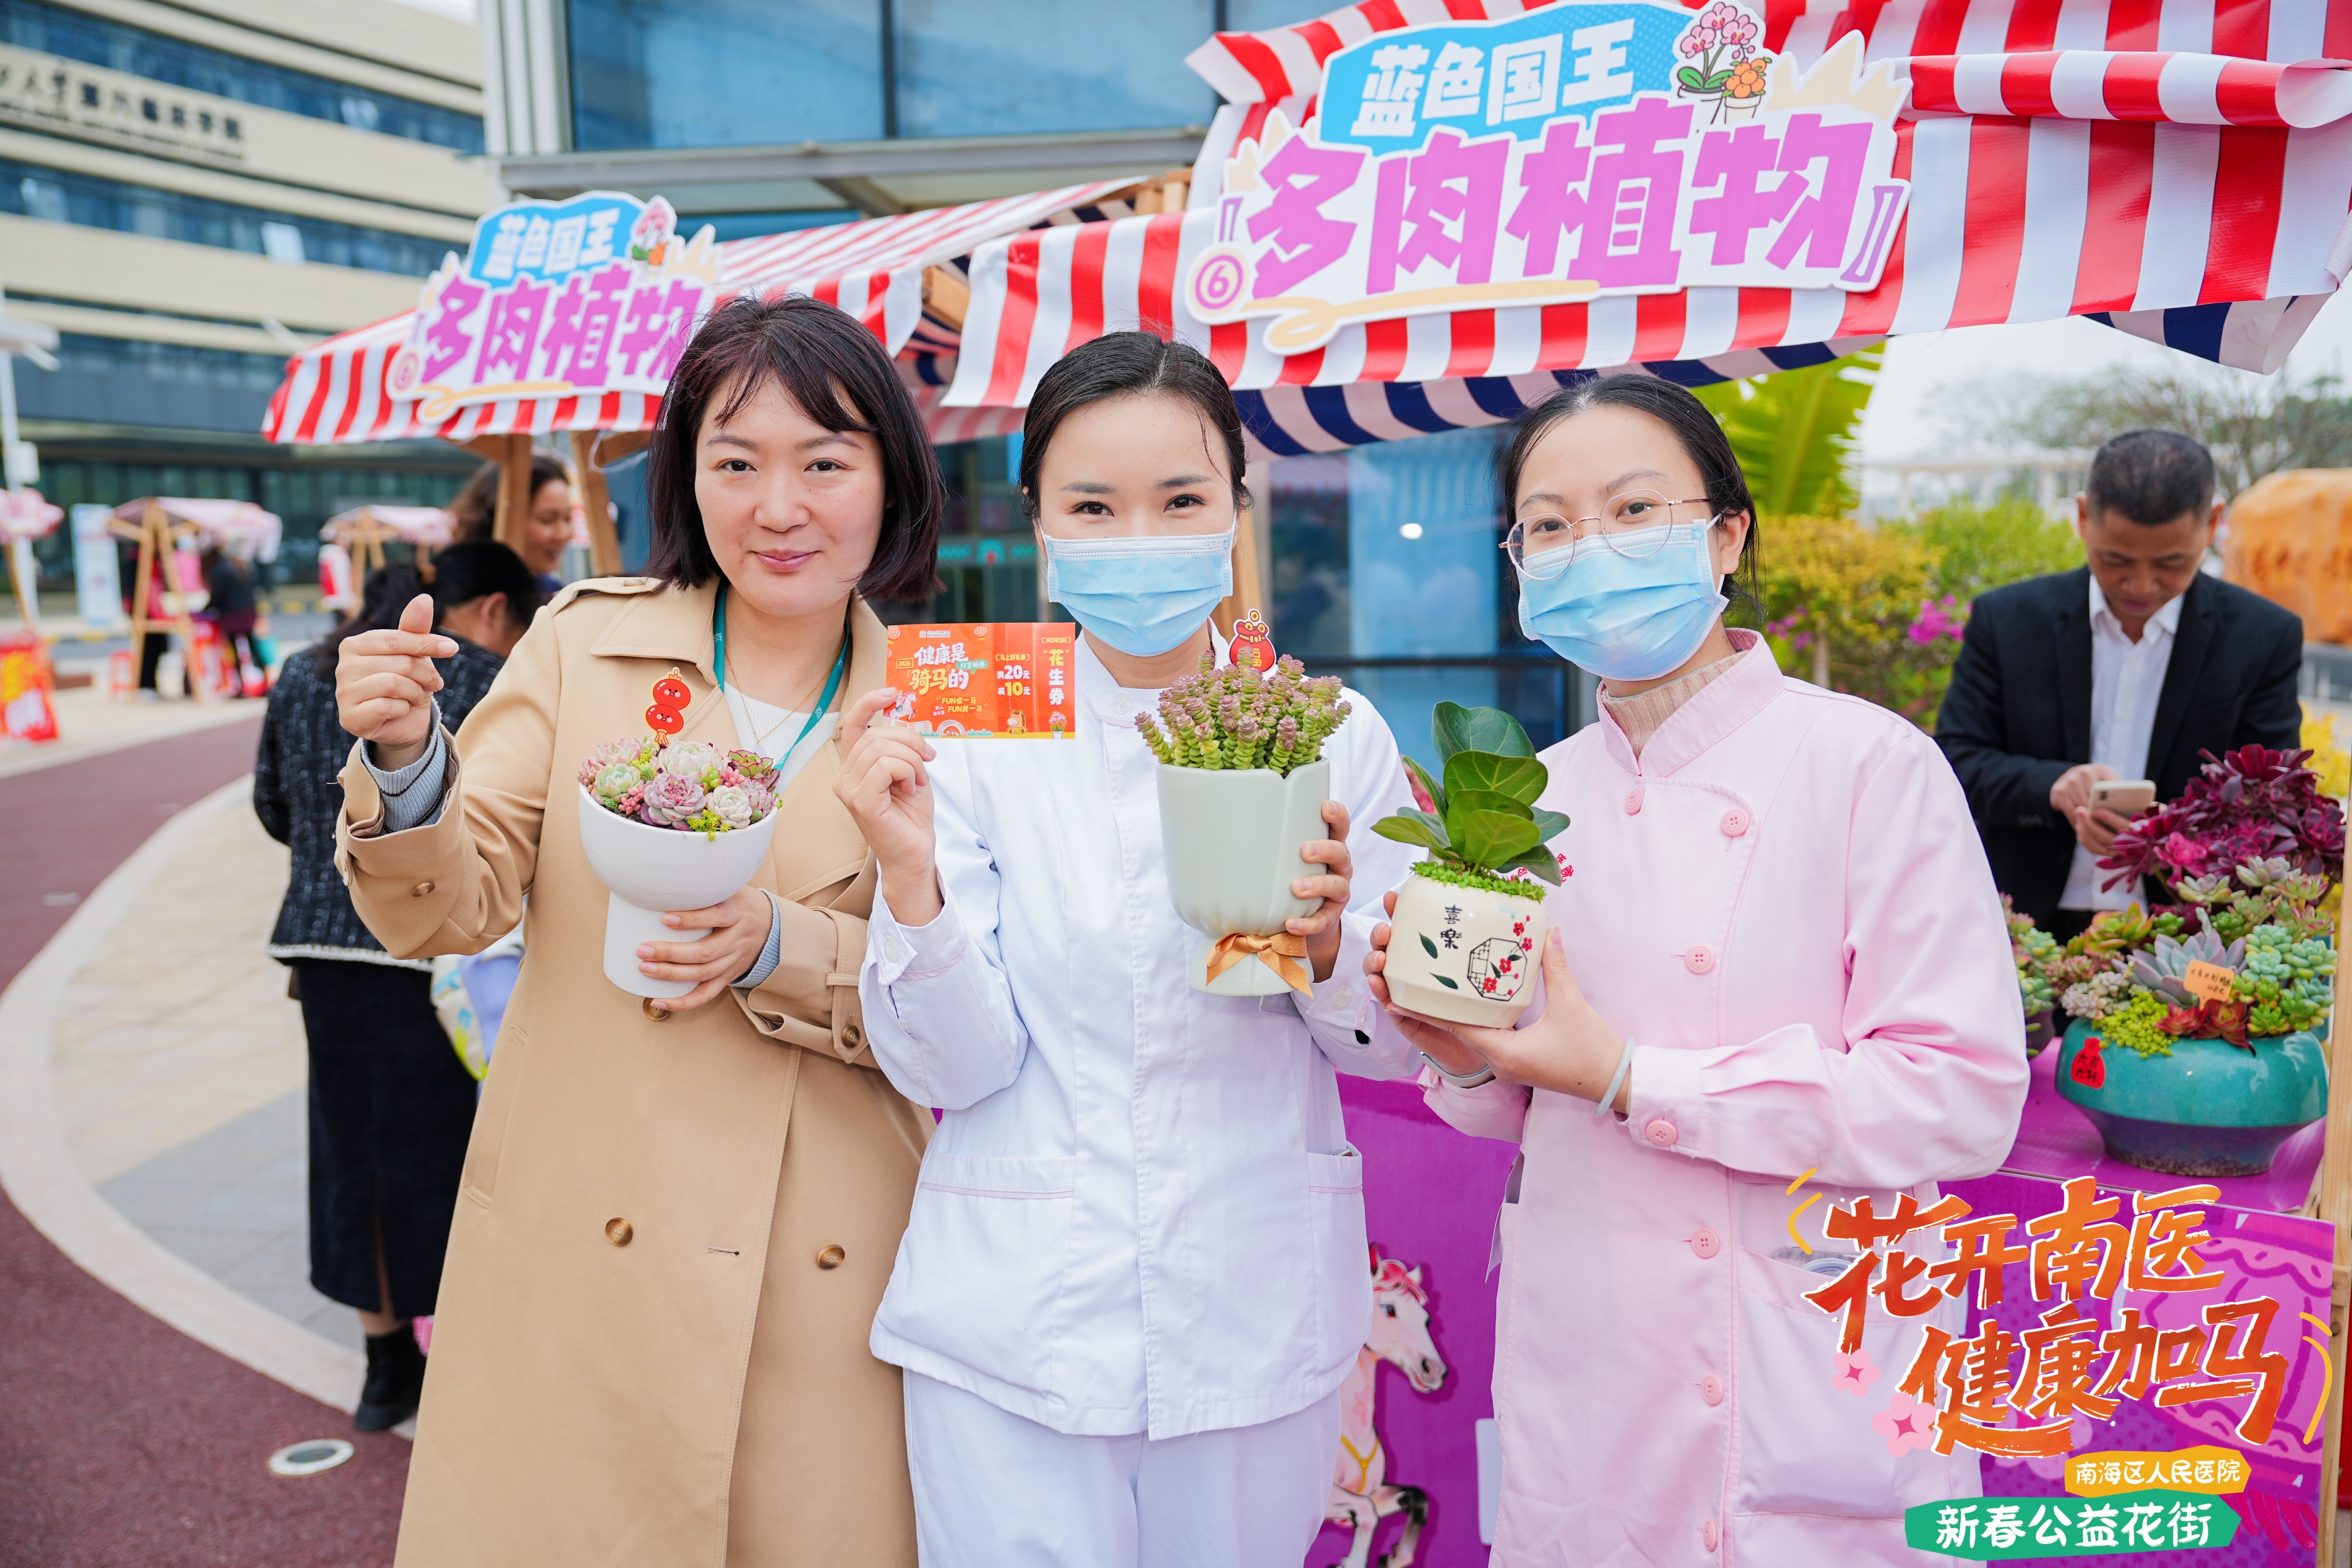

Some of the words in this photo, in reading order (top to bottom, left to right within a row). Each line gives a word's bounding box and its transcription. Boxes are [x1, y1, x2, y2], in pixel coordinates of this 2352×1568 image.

[1349, 17, 1637, 139] 蓝色国王
[1247, 97, 1874, 300] 多肉植物
[481, 207, 621, 280] 蓝色国王
[1208, 264, 1229, 298] 6
[421, 263, 704, 387] 多肉植物
[914, 642, 969, 666] 健康是
[997, 664, 1030, 680] 满20元
[998, 681, 1031, 696] 减10元
